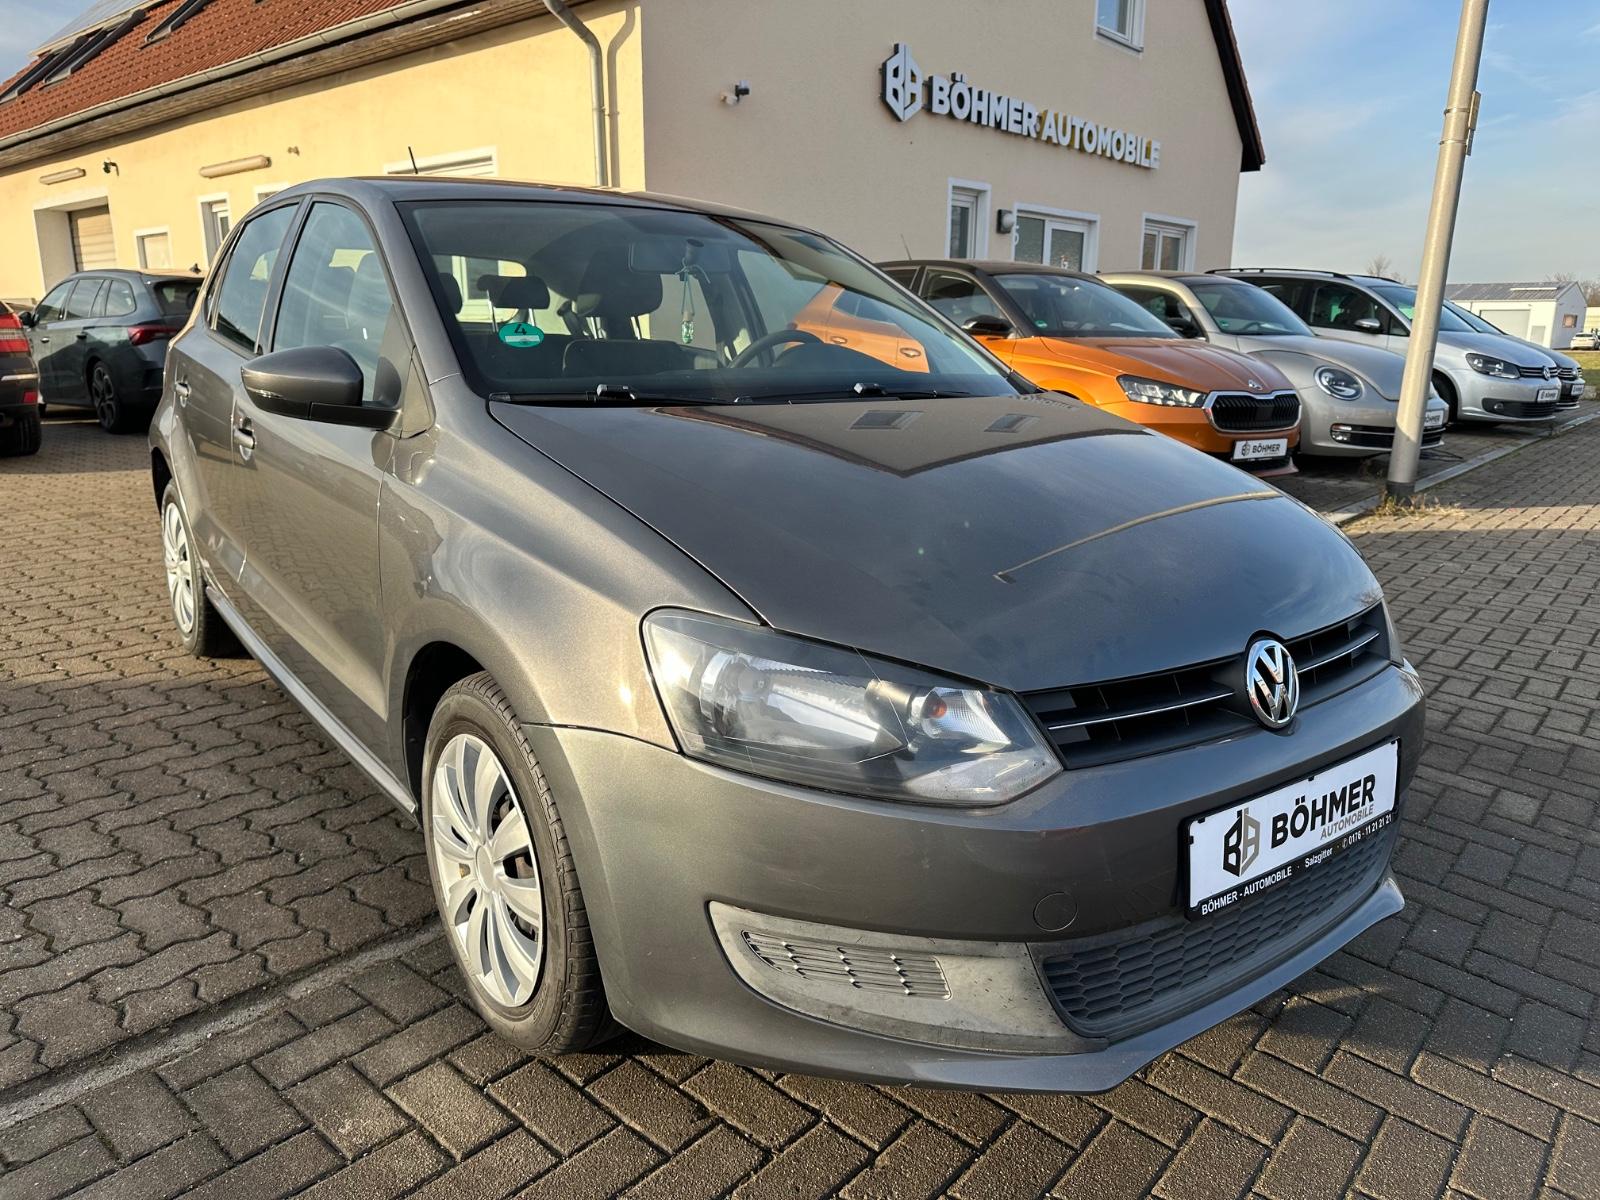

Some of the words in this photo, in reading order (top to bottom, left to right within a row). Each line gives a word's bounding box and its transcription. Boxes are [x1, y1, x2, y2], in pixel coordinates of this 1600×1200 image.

[930, 72, 1037, 138] BÖHMER
[1041, 110, 1160, 169] AUTOMOBILE
[514, 323, 527, 335] 4
[1271, 774, 1376, 849] BÖHMER
[1320, 803, 1374, 840] AUTOMOBILE
[1201, 891, 1238, 915] BÖHMER
[1243, 866, 1292, 897] AUTOMOBILE
[1304, 847, 1333, 868] Salzgitter
[1348, 830, 1361, 845] 0176
